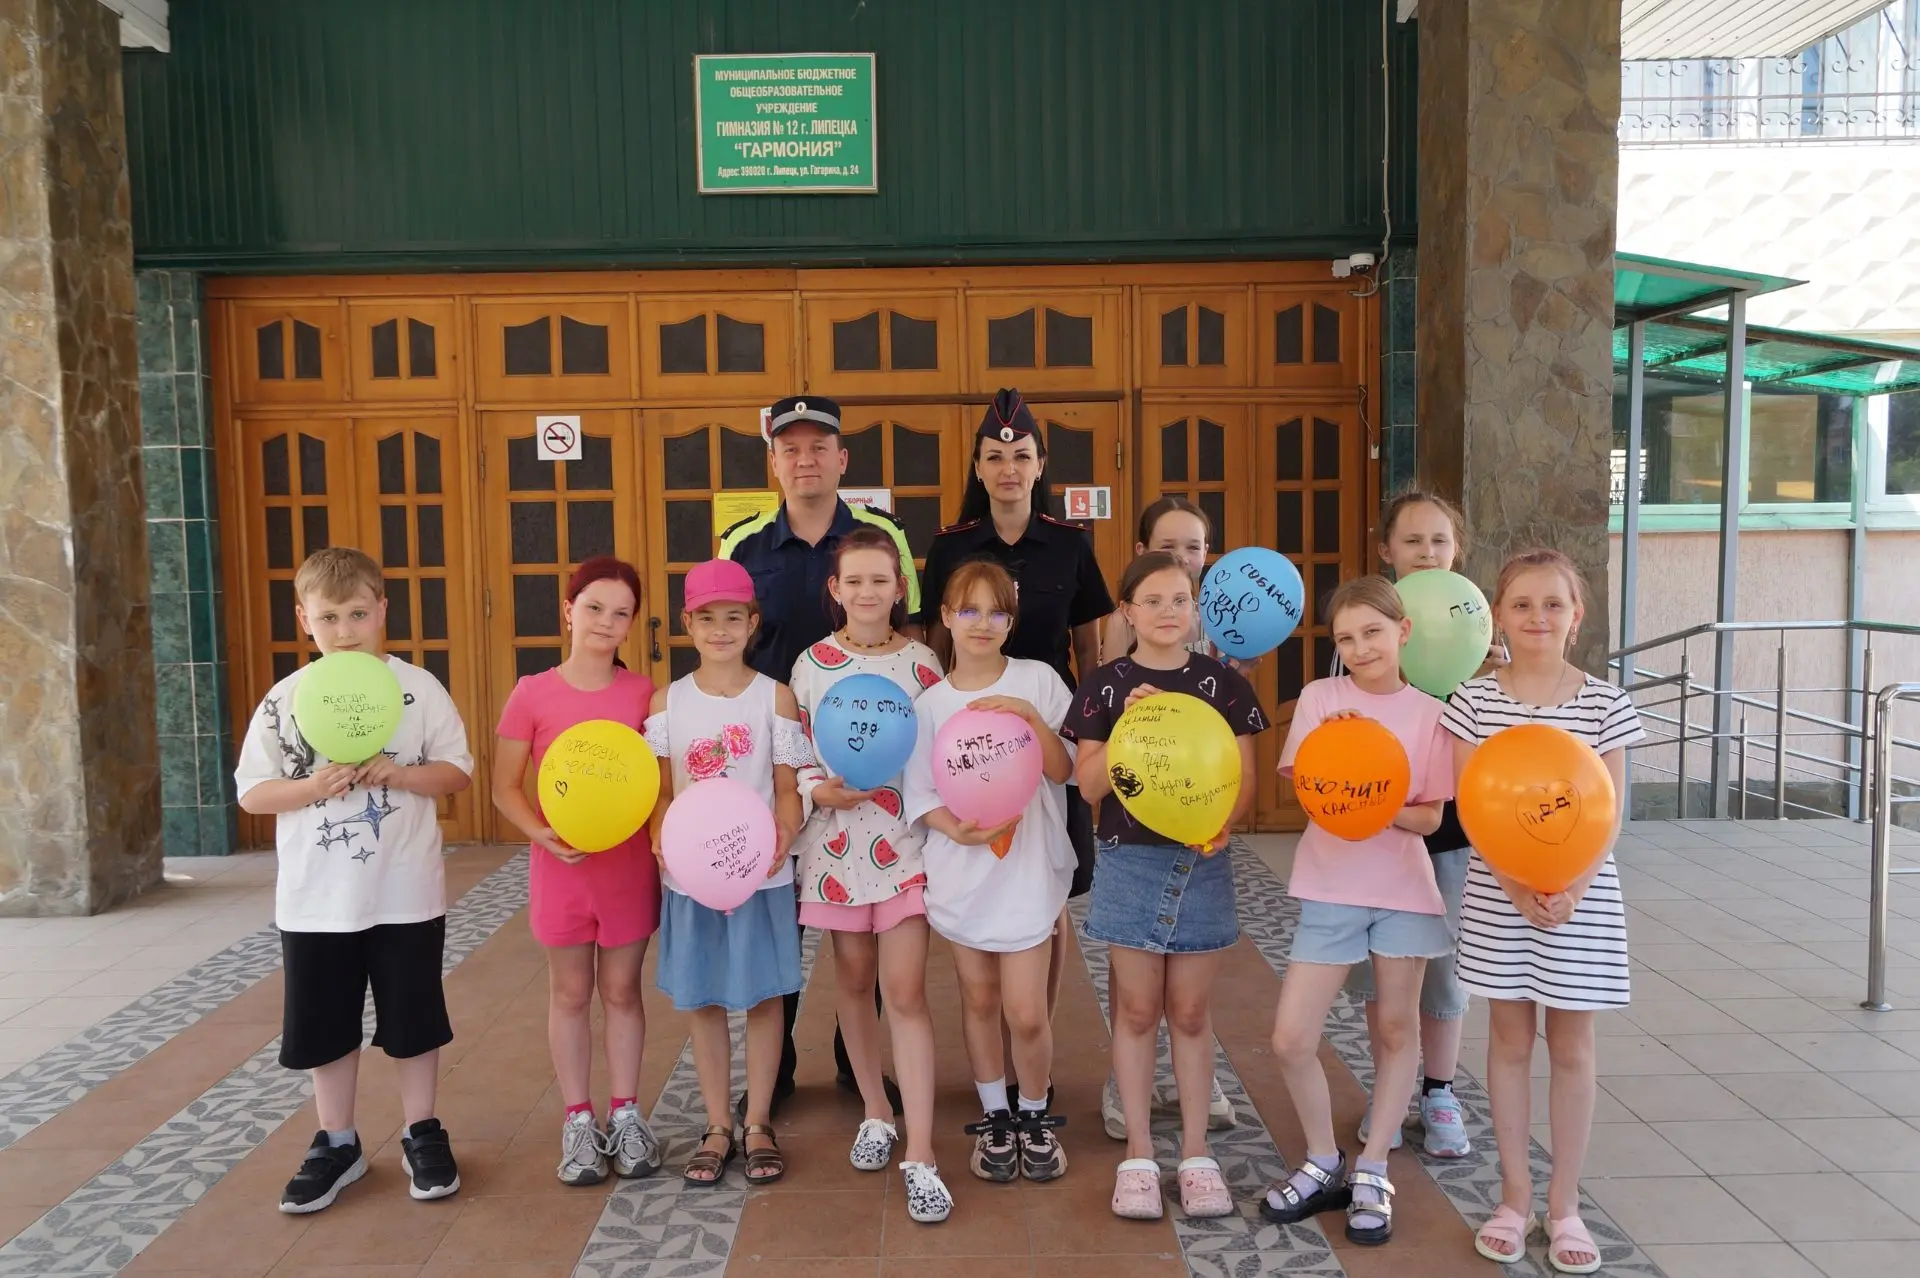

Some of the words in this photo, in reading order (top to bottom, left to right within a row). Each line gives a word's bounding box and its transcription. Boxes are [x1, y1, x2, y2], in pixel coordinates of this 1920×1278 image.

[715, 69, 795, 82] МУНИЦИПАЛЬНОЕ
[797, 68, 857, 81] БЮДЖЕТНОЕ
[730, 85, 843, 99] ОБЩЕОБРАЗОВАТЕЛЬНОЕ
[755, 102, 818, 115] УЧРЕЖДЕНИЕ
[716, 120, 771, 137] ГИМНАЗИЯ
[773, 121, 784, 136] №
[786, 121, 798, 136] 12
[801, 124, 809, 136] г.
[811, 119, 858, 138] ЛИПЕЦКА
[850, 164, 859, 175] 24
